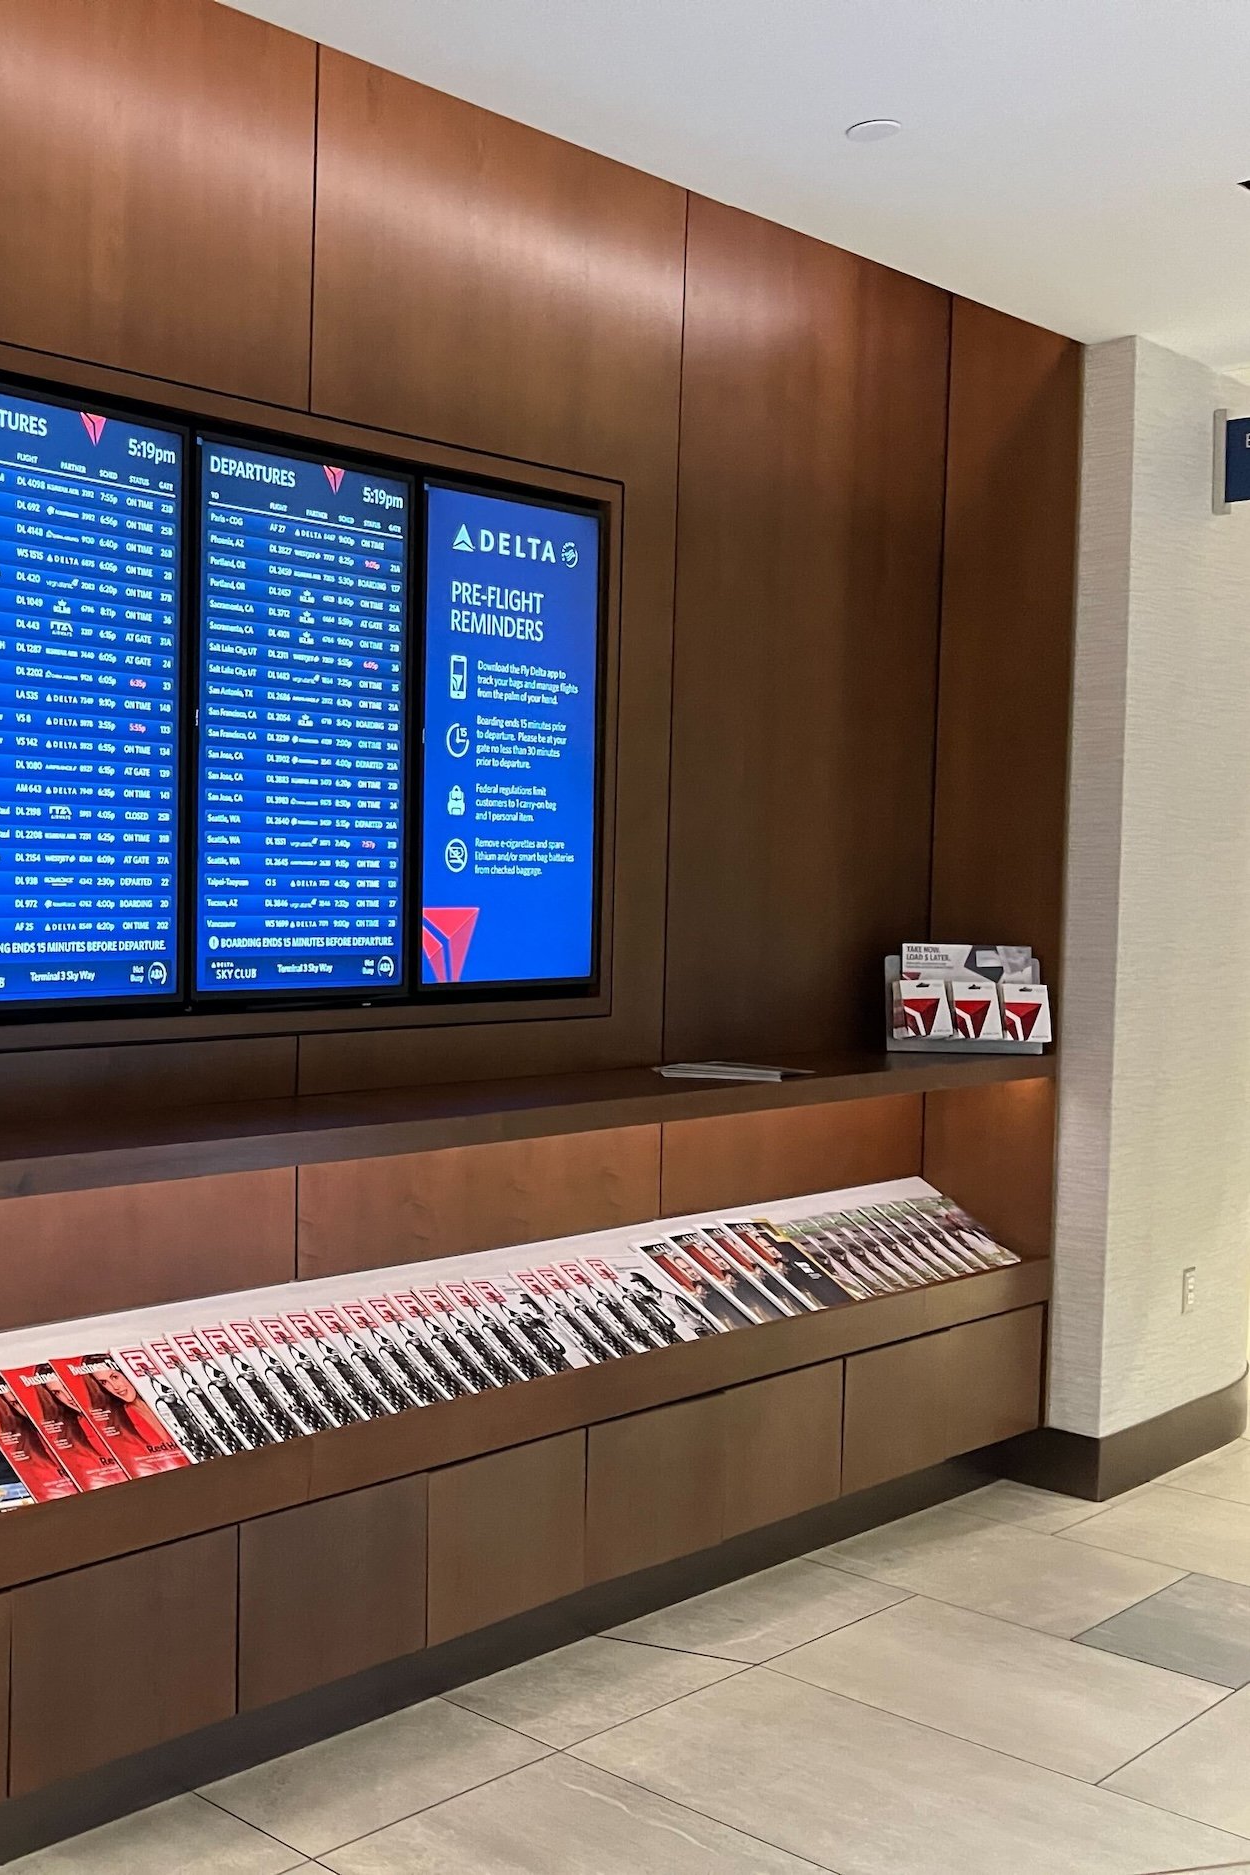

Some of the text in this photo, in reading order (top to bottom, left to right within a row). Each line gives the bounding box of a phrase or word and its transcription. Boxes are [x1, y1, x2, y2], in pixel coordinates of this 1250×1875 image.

[129, 438, 175, 464] 5:19pm
[17, 452, 38, 464] FLIGHT
[61, 462, 86, 473] PARTNER
[99, 469, 118, 480] SCHED
[129, 475, 150, 486] STATUS
[159, 481, 173, 491] GATE
[211, 456, 295, 487] DEPARTURES
[363, 487, 403, 509] 5:19pm
[481, 530, 555, 562] DELTA
[452, 582, 543, 613] PRE-FLIGHT
[451, 610, 543, 641] REMINDERS
[478, 660, 566, 680] Download the Fly Delta app to
[478, 675, 578, 694] track your bags and manage flights
[477, 688, 558, 705] from the palm of your hand.
[477, 715, 566, 732] Boarding ends 15 minutes prior
[460, 727, 468, 736] 15
[476, 729, 567, 746] to departure. Please be at your
[476, 744, 490, 754] gate
[500, 744, 512, 754] less
[513, 745, 527, 755] than
[527, 746, 536, 756] 30
[537, 747, 560, 758] minutes
[476, 757, 531, 769] prior to departure.
[476, 783, 546, 796] Federal regulations limit
[476, 798, 507, 808] customers
[508, 799, 516, 808] to
[520, 801, 545, 810] carry-on
[545, 800, 557, 811] bag
[475, 811, 488, 820] and
[492, 812, 518, 822] personal
[519, 812, 534, 822] item.
[475, 838, 565, 850] Remove e-cigarettes and spare
[475, 851, 574, 863] lithium and/or smart bag batteries
[475, 864, 542, 876] from checked baggage.
[120, 878, 152, 886] DEPARTED
[120, 900, 152, 908] BOARDING
[12, 942, 36, 953] ENDS
[37, 942, 46, 953] 15
[47, 941, 86, 952] MINUTES
[87, 941, 117, 952] BEFORE
[119, 940, 166, 951] DEPARTURE.
[221, 936, 394, 948] BOARDING ENDS 15 MINUTES BEFORE DEPARTURE.
[30, 970, 95, 982] Terminal 3 Sky Way
[216, 968, 257, 979] SKY CLUB
[146, 1442, 168, 1454] Red
[99, 1457, 115, 1466] Re
